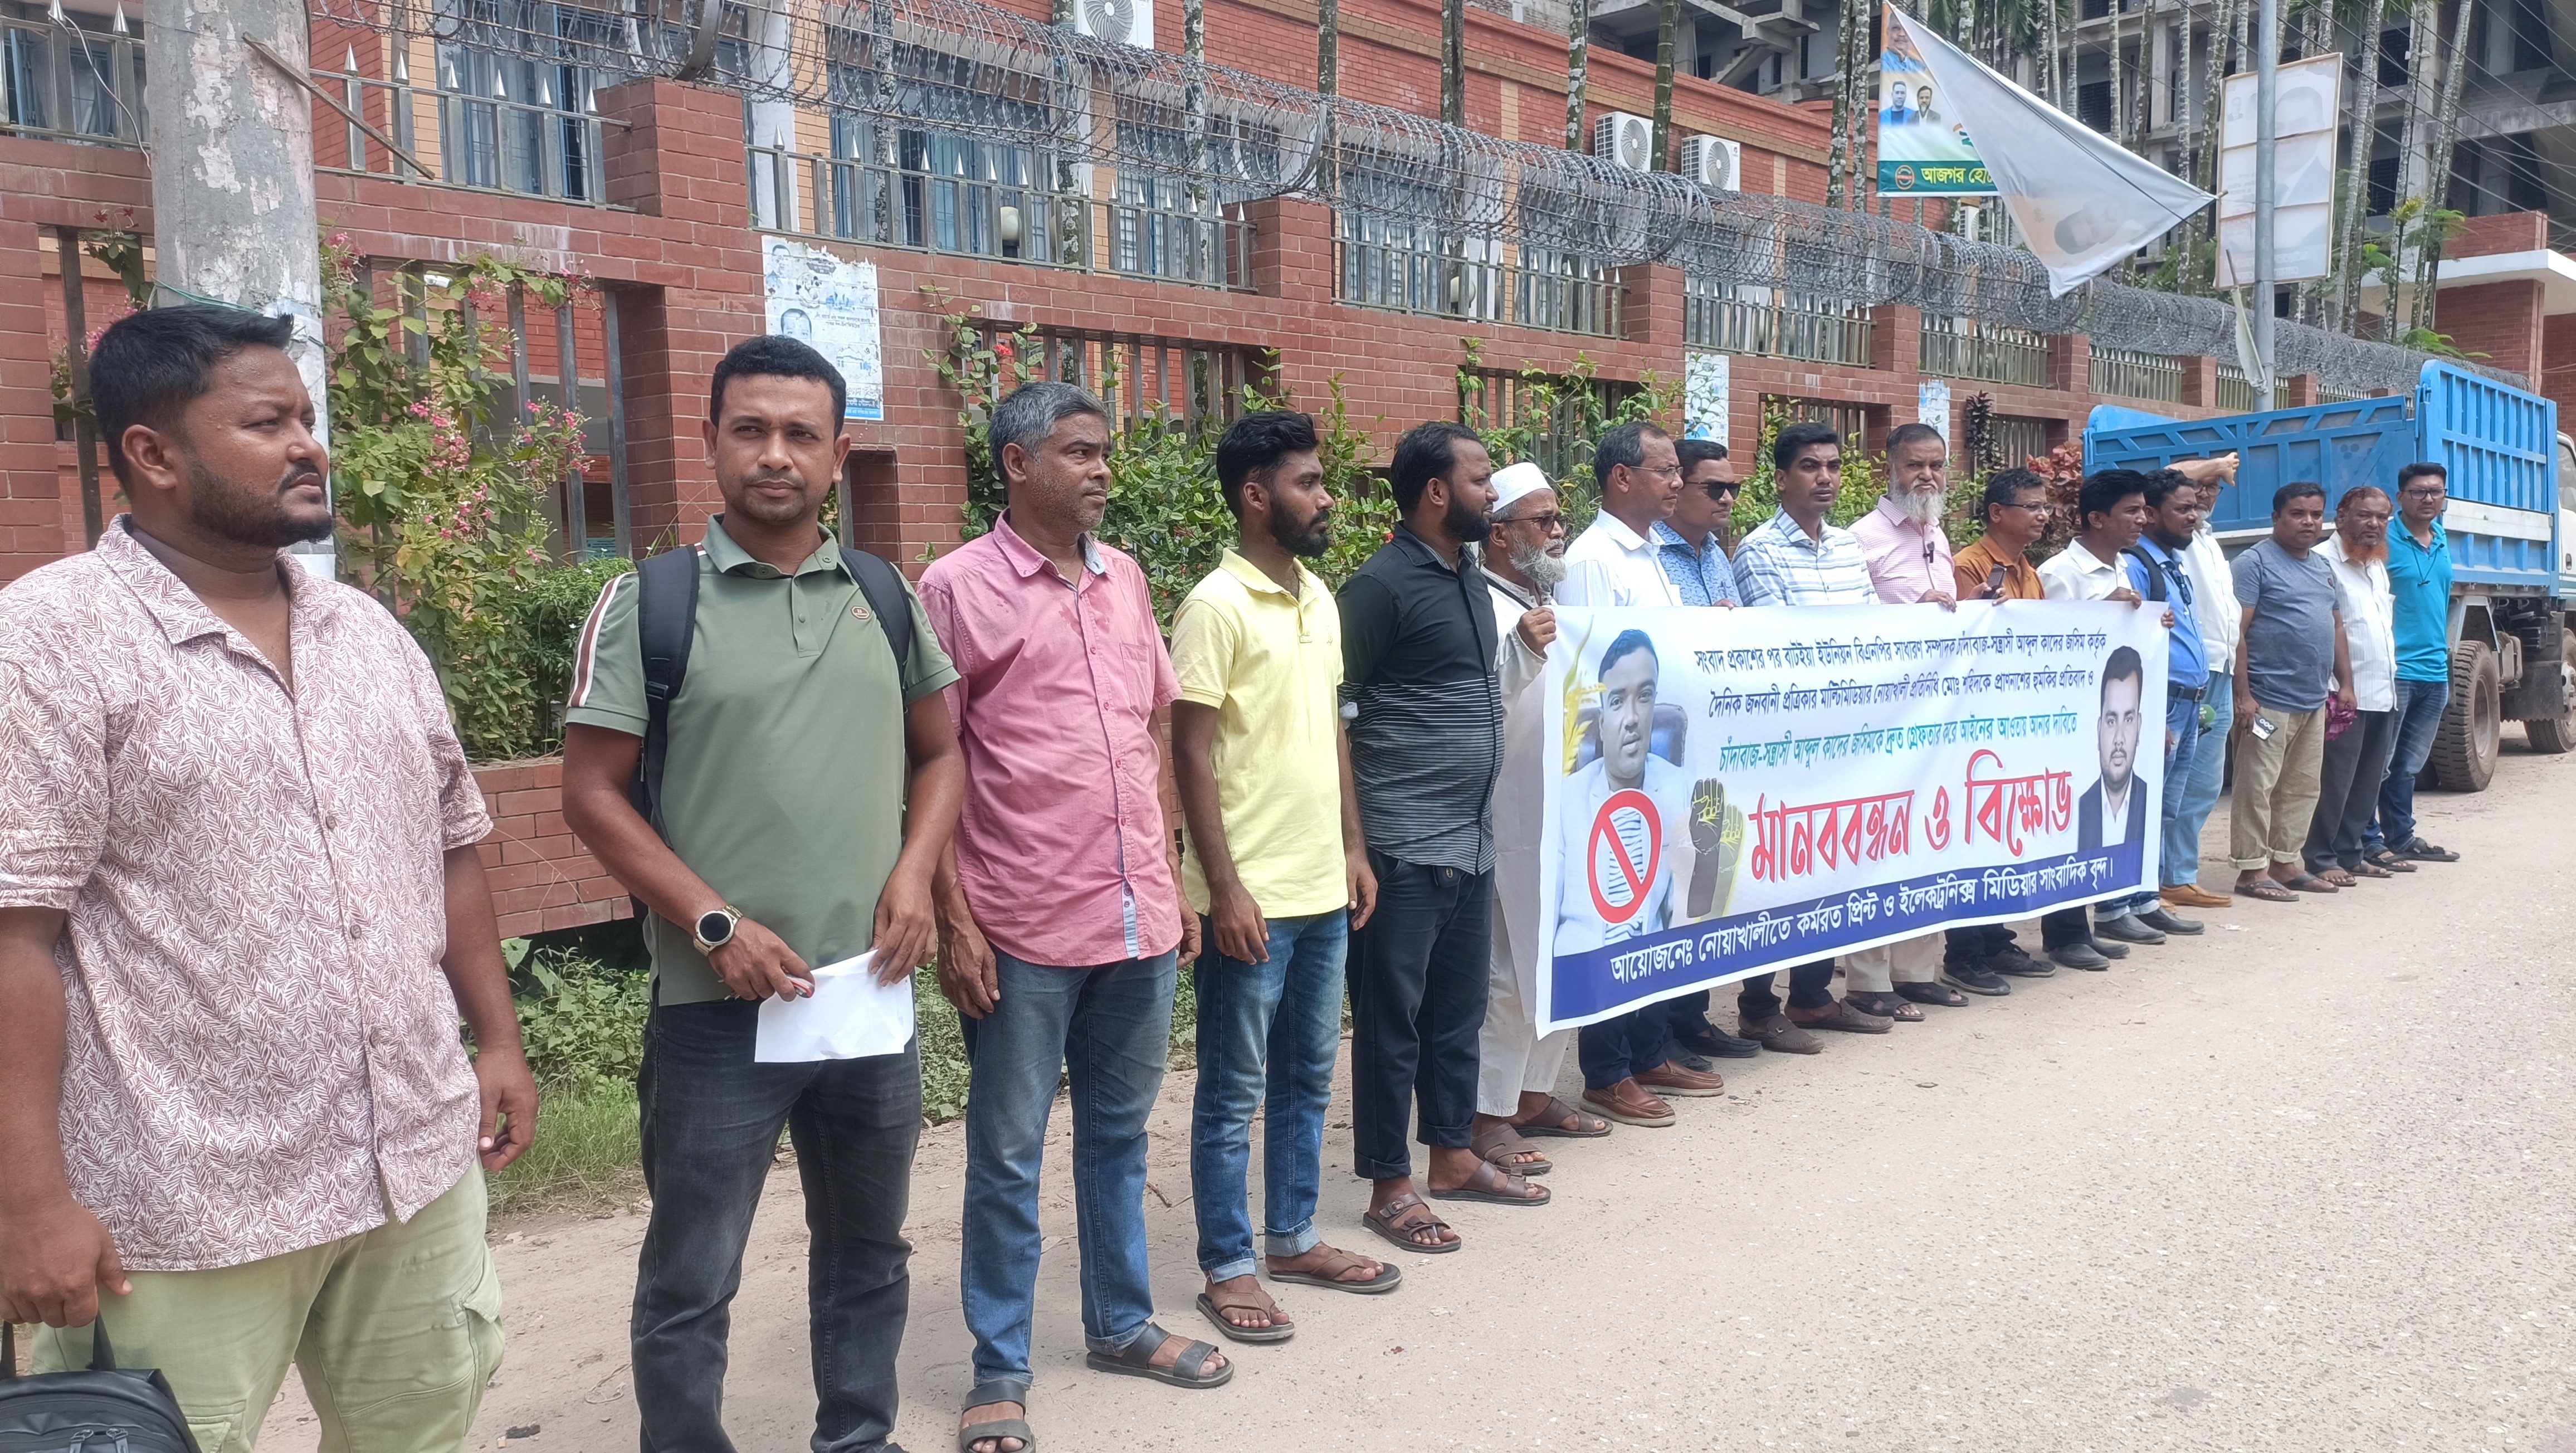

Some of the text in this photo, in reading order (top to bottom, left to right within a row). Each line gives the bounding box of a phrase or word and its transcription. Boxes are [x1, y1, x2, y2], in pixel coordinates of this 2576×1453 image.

[1920, 166, 1966, 184] আজগর
[1694, 649, 1725, 675] সংবাদ
[1728, 648, 1765, 672] প্রকাশের
[1767, 646, 1782, 669] পর
[1816, 638, 1853, 667] ইউনিয়ন
[1853, 636, 1893, 664] বিএনপির
[1894, 640, 1923, 661] সাধারণ
[2041, 633, 2063, 652] কাদের
[2066, 628, 2085, 651] জসিম
[2087, 627, 2106, 660] কর্তৃক
[1709, 686, 1743, 718] দৈনিক
[1745, 682, 1780, 715] জনবানী
[1874, 674, 1910, 704] নোয়াখালী
[1941, 676, 1959, 696] মোঃ
[2033, 665, 2057, 694] হুমকির
[2059, 664, 2086, 690] প্রতিবাদ
[2088, 670, 2094, 686] ও
[1822, 733, 1851, 762] কাদের
[1885, 727, 1904, 757] দ্রুত
[1907, 723, 1942, 750] গ্রেফতার
[1943, 721, 1958, 745] করে
[1960, 711, 1994, 743] আইনের
[2029, 714, 2051, 738] আনার
[2053, 705, 2077, 735] দাবিতে
[1748, 748, 2072, 884] মানববন্ধন ও বিক্ষোভ
[1609, 938, 1693, 984] আয়োজনেঃ
[1698, 911, 1794, 962] নোয়াখালীতে
[1797, 899, 1843, 938] কর্মরত
[1846, 890, 1879, 927] প্রিন্ট
[1882, 895, 1895, 917] ও
[1981, 867, 2037, 901] মিডিয়ার
[2038, 856, 2087, 893] সাংবাদিক
